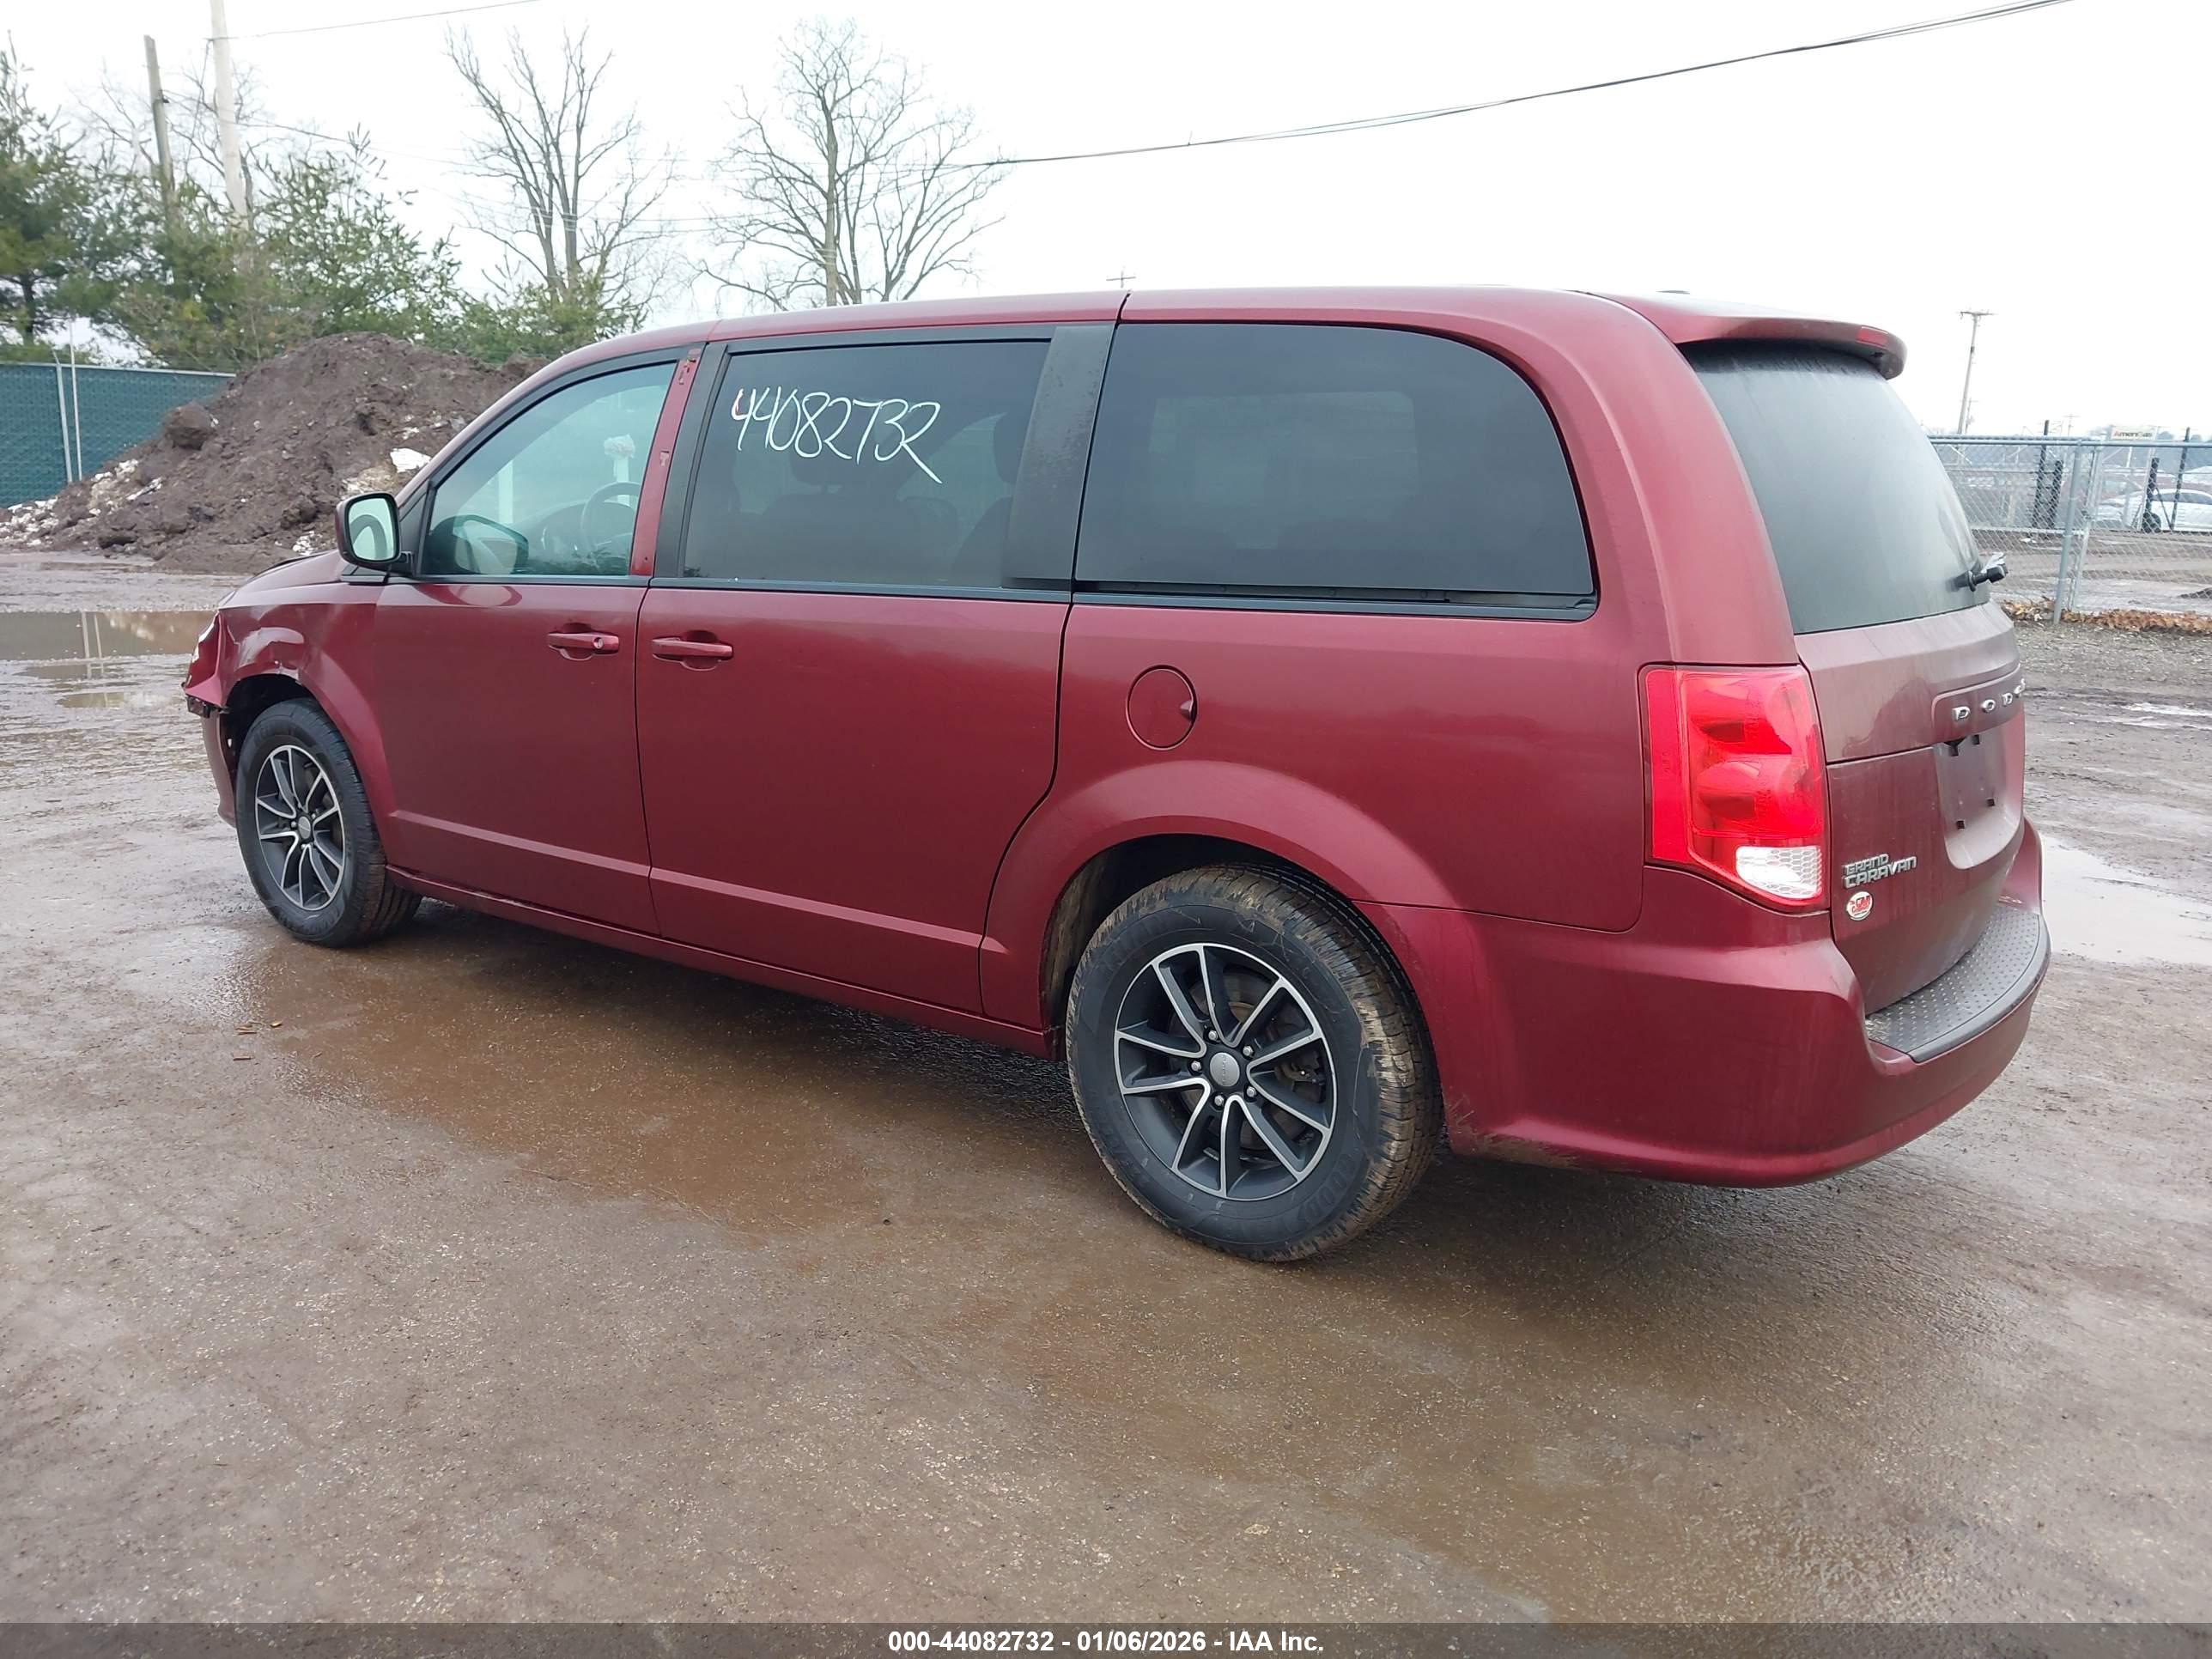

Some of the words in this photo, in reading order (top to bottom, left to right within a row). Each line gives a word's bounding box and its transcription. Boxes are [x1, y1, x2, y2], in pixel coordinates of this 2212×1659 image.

[731, 386, 942, 483] 44082732
[1951, 678, 2027, 720] DOD
[1844, 854, 1889, 875] GRAND
[1844, 856, 1917, 889] CARAVAN
